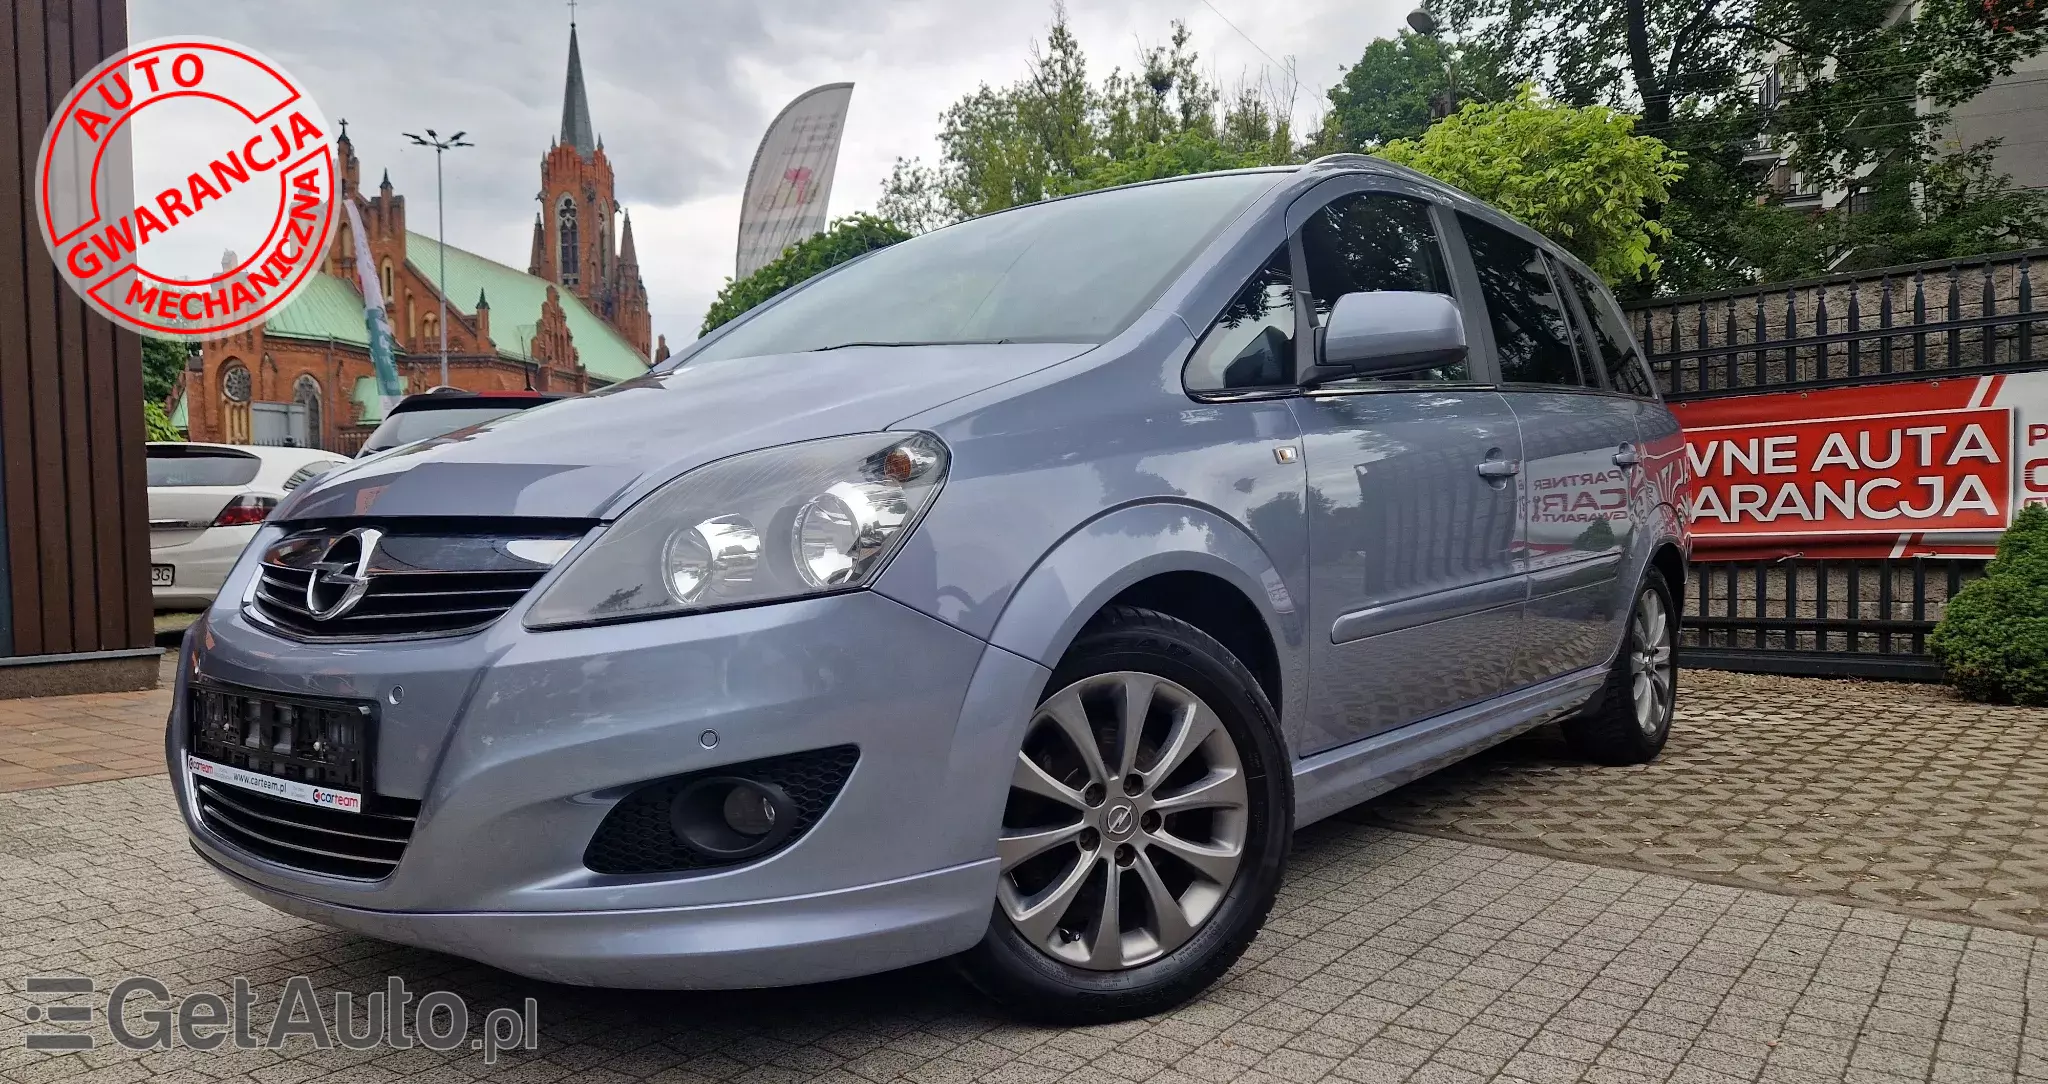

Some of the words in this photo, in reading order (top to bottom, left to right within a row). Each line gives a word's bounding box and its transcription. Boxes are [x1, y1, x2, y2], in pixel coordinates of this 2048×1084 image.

[1811, 423, 2001, 472] AUTA
[1691, 474, 2000, 524] ARANCJA
[192, 760, 214, 774] carteam
[233, 772, 287, 794] www.carteam.pl
[320, 792, 359, 809] carteam
